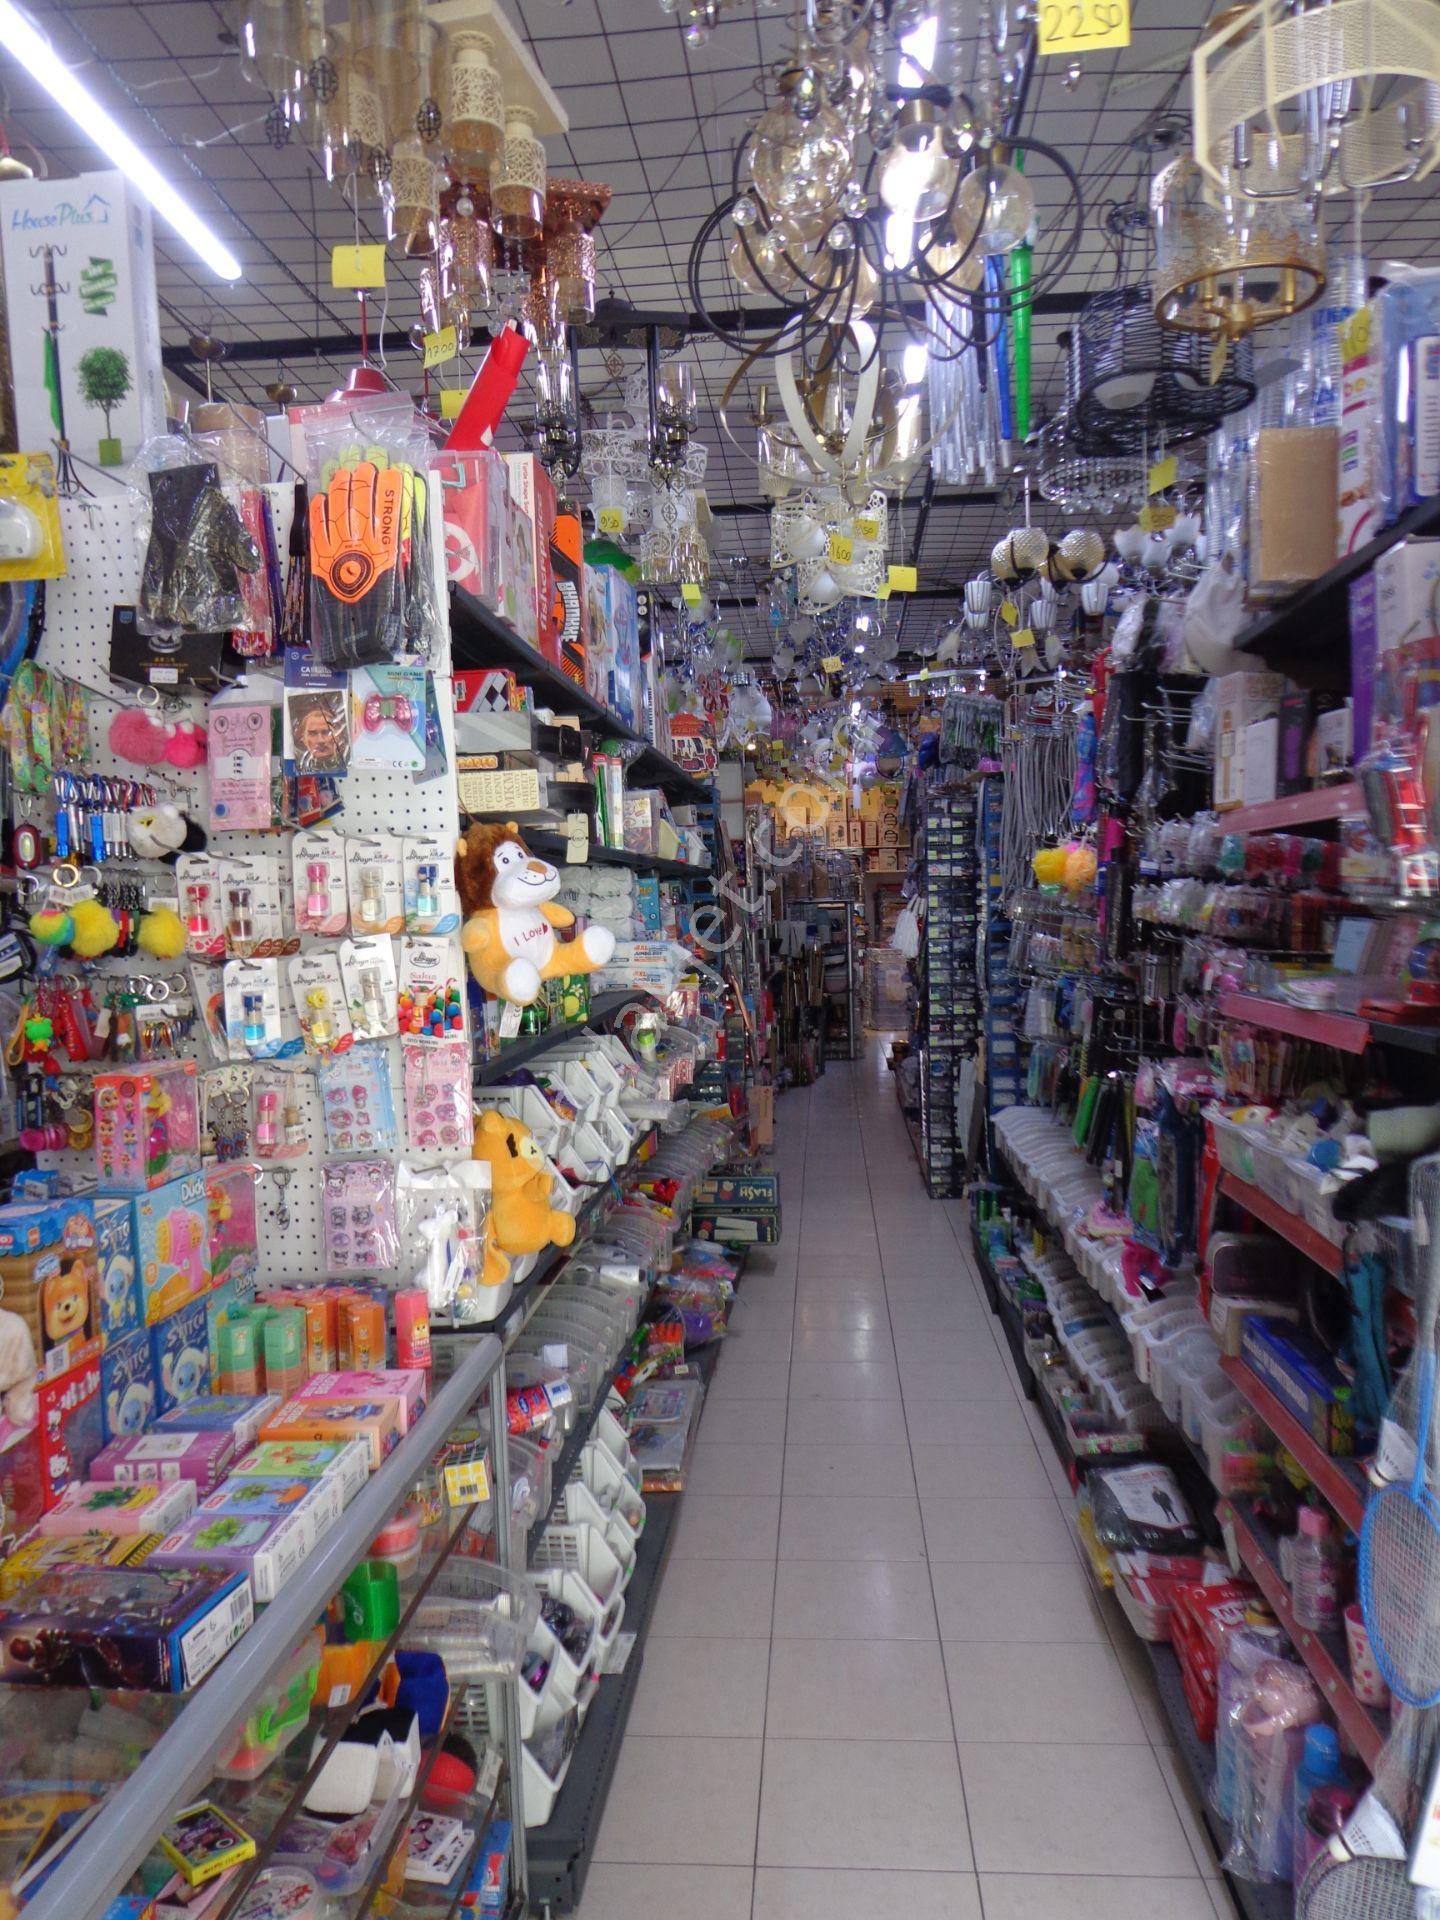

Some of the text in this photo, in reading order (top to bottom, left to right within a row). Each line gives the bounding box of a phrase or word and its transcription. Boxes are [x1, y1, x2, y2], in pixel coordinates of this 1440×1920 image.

[382, 488, 395, 546] STRONG
[181, 1178, 206, 1201] Duck
[739, 1186, 773, 1202] FLASH
